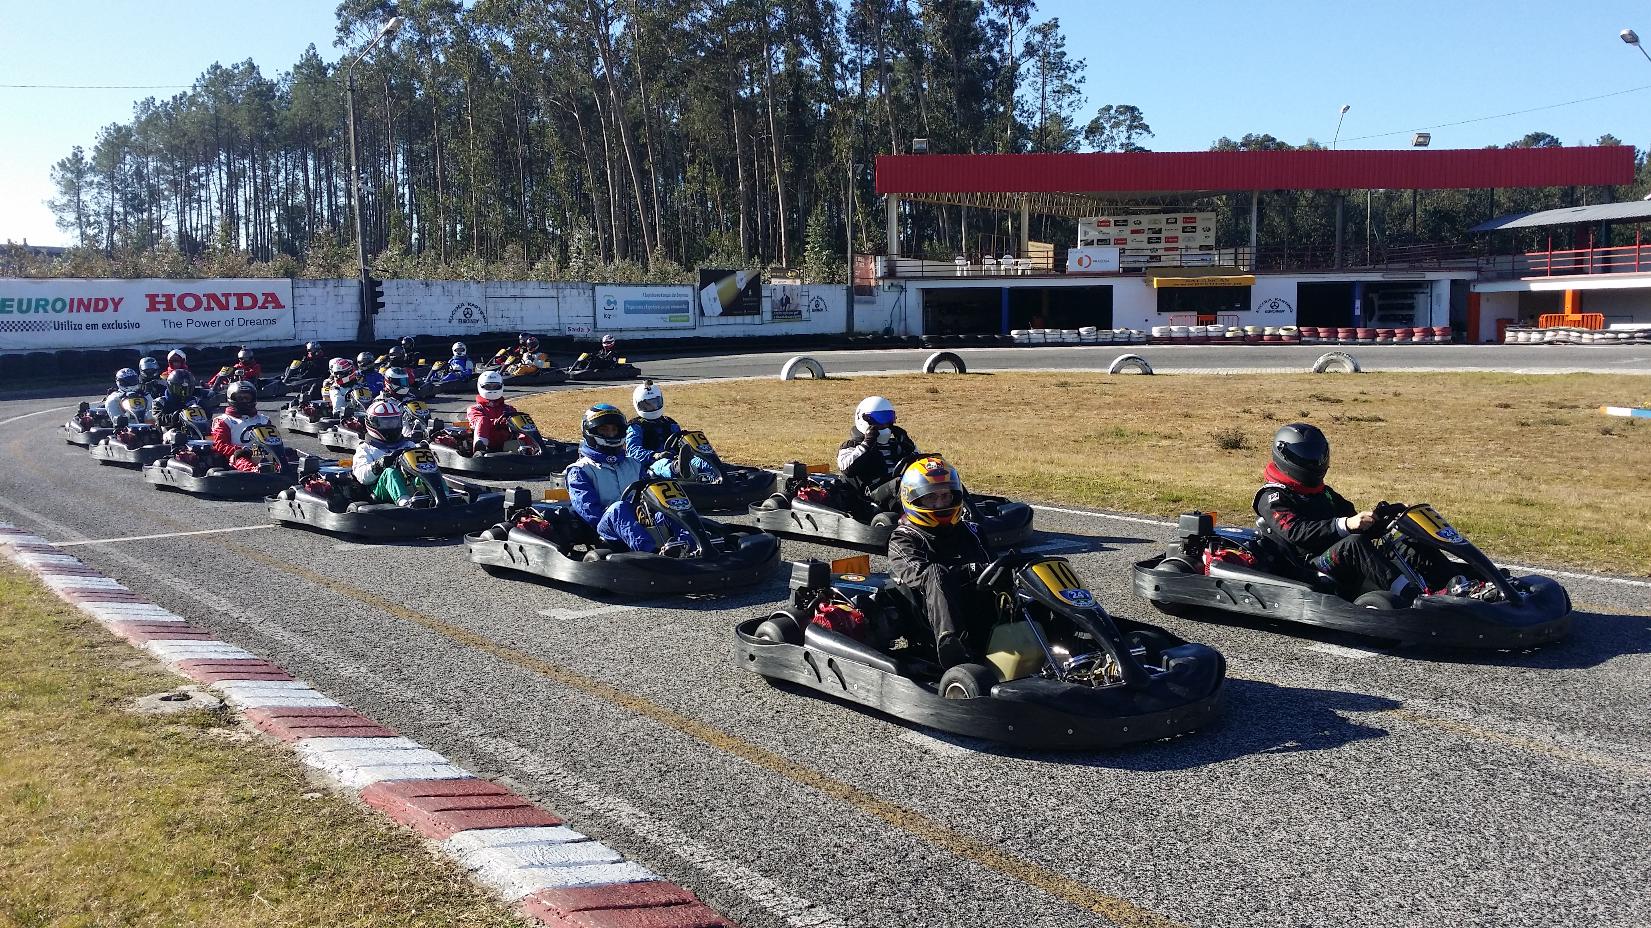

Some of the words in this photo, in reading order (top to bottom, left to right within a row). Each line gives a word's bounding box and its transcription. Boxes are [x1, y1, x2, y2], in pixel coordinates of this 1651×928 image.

[145, 293, 285, 312] HONDA
[53, 320, 82, 330] Utiliza
[86, 322, 98, 330] em
[102, 319, 140, 330] exclusivo
[161, 319, 183, 328] The
[187, 319, 220, 328] Power
[225, 318, 234, 326] of
[238, 317, 277, 326] Dreams
[258, 427, 276, 438] 12
[691, 433, 709, 445] 19
[1046, 561, 1081, 589] 10
